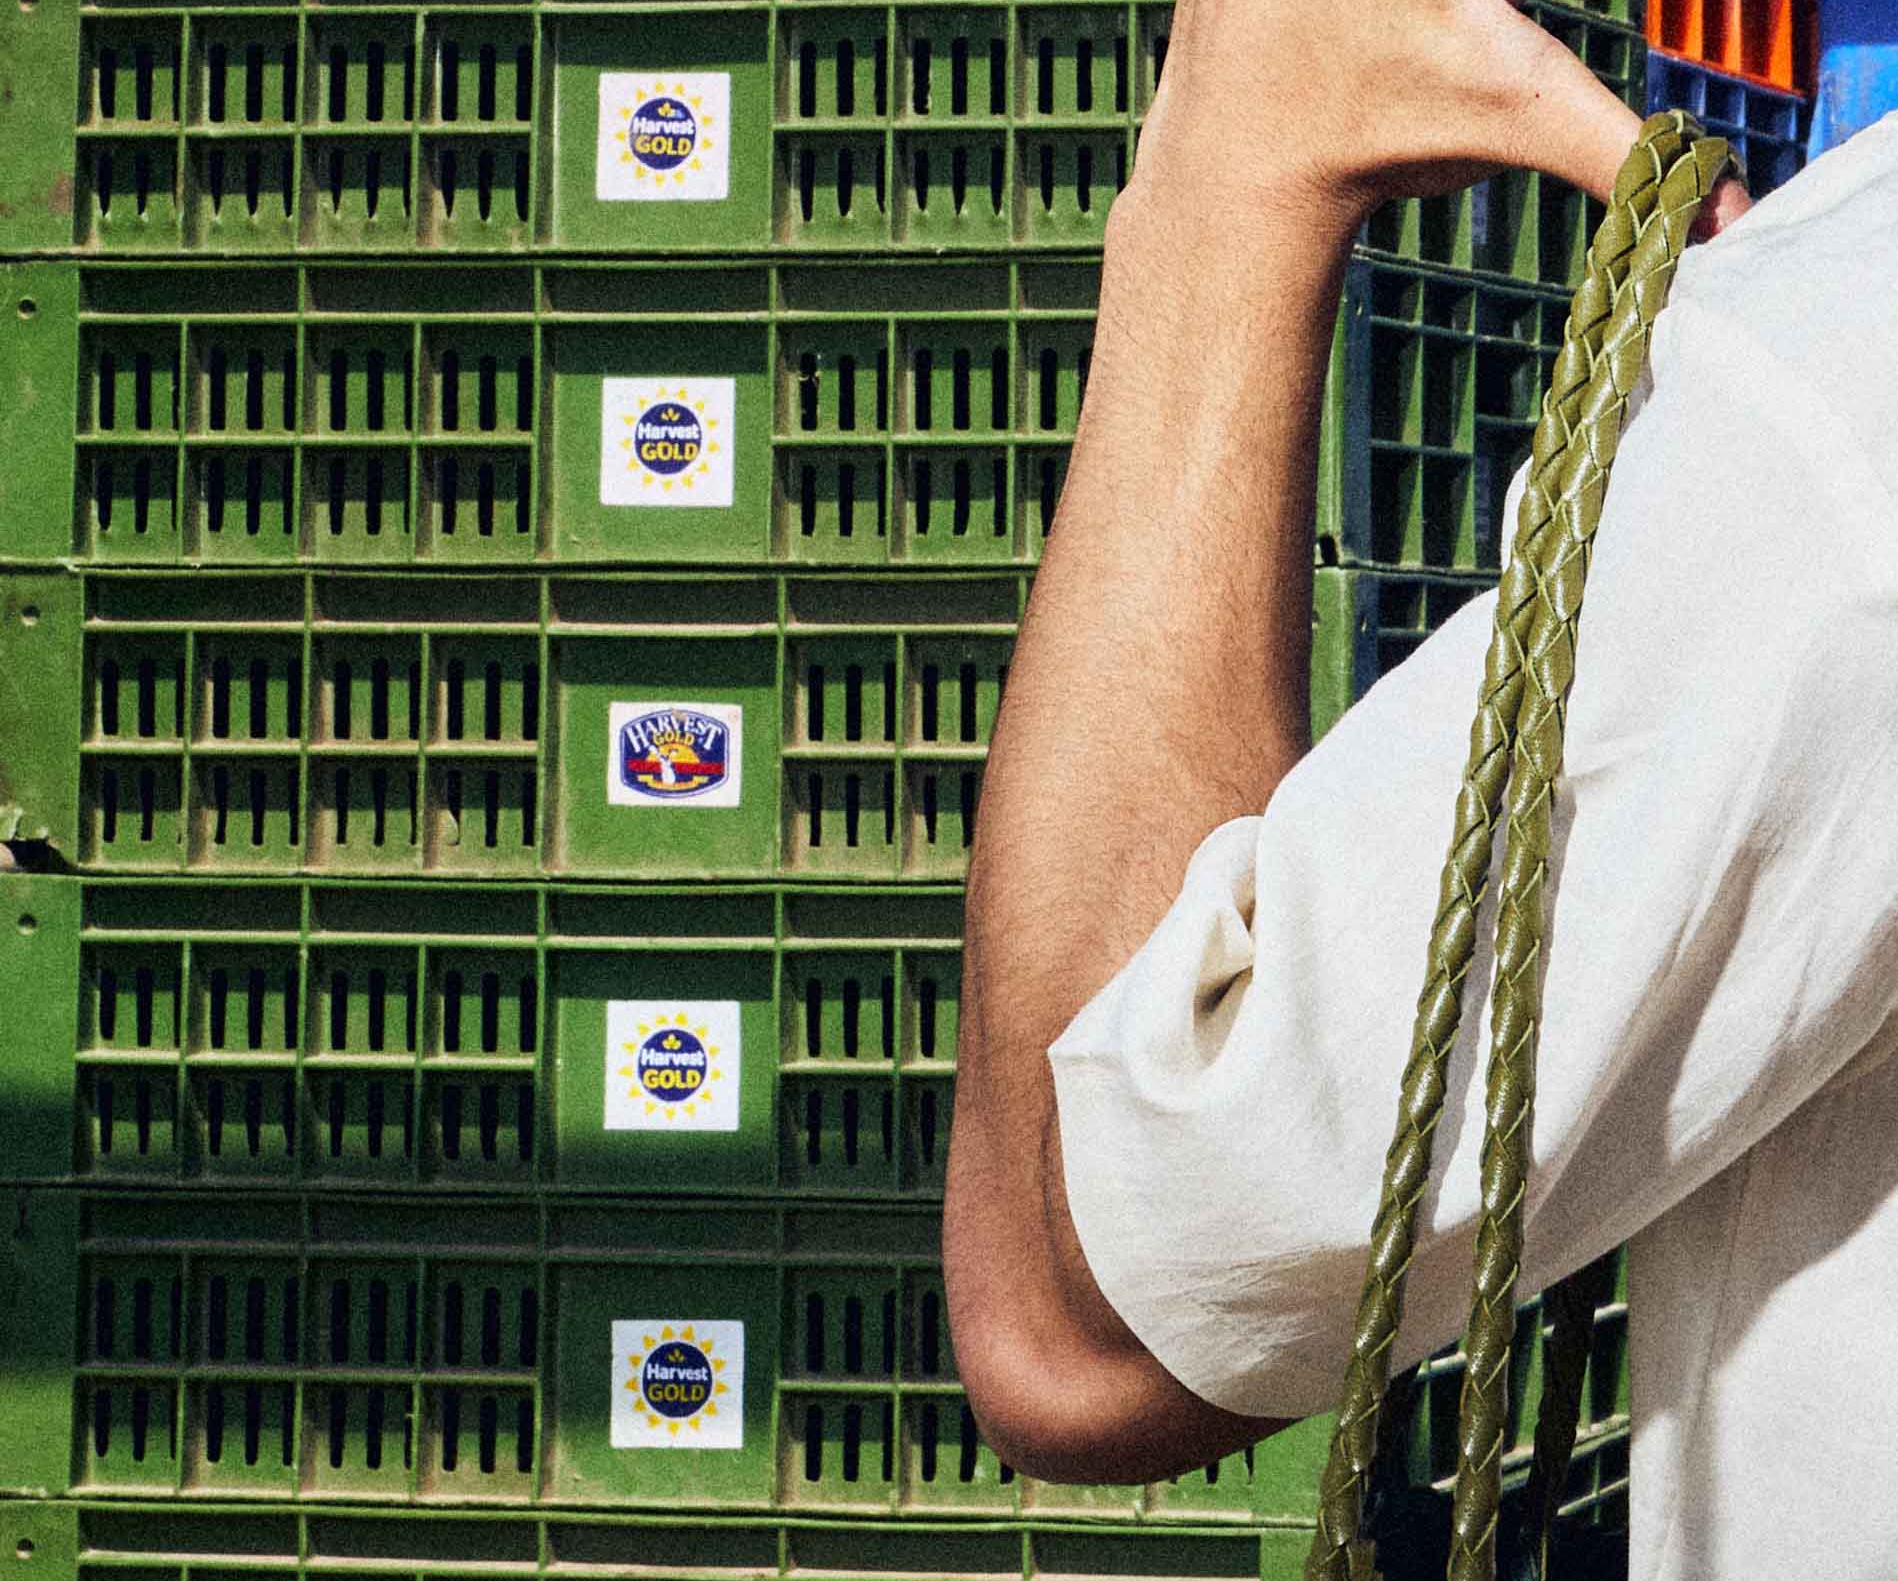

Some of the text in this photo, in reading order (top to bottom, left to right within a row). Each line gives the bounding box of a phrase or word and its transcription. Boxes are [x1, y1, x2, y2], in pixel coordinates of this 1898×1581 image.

[633, 117, 694, 134] Harvest
[635, 135, 692, 155] GOLD
[638, 423, 699, 439] Harvest
[640, 441, 698, 461] GOLD
[626, 715, 722, 753] HARVEST
[653, 730, 694, 746] GOLD
[641, 1048, 704, 1066] Harvest
[643, 1069, 700, 1089] GOLD
[646, 1364, 708, 1380] Harvest
[647, 1384, 705, 1402] GOLD
